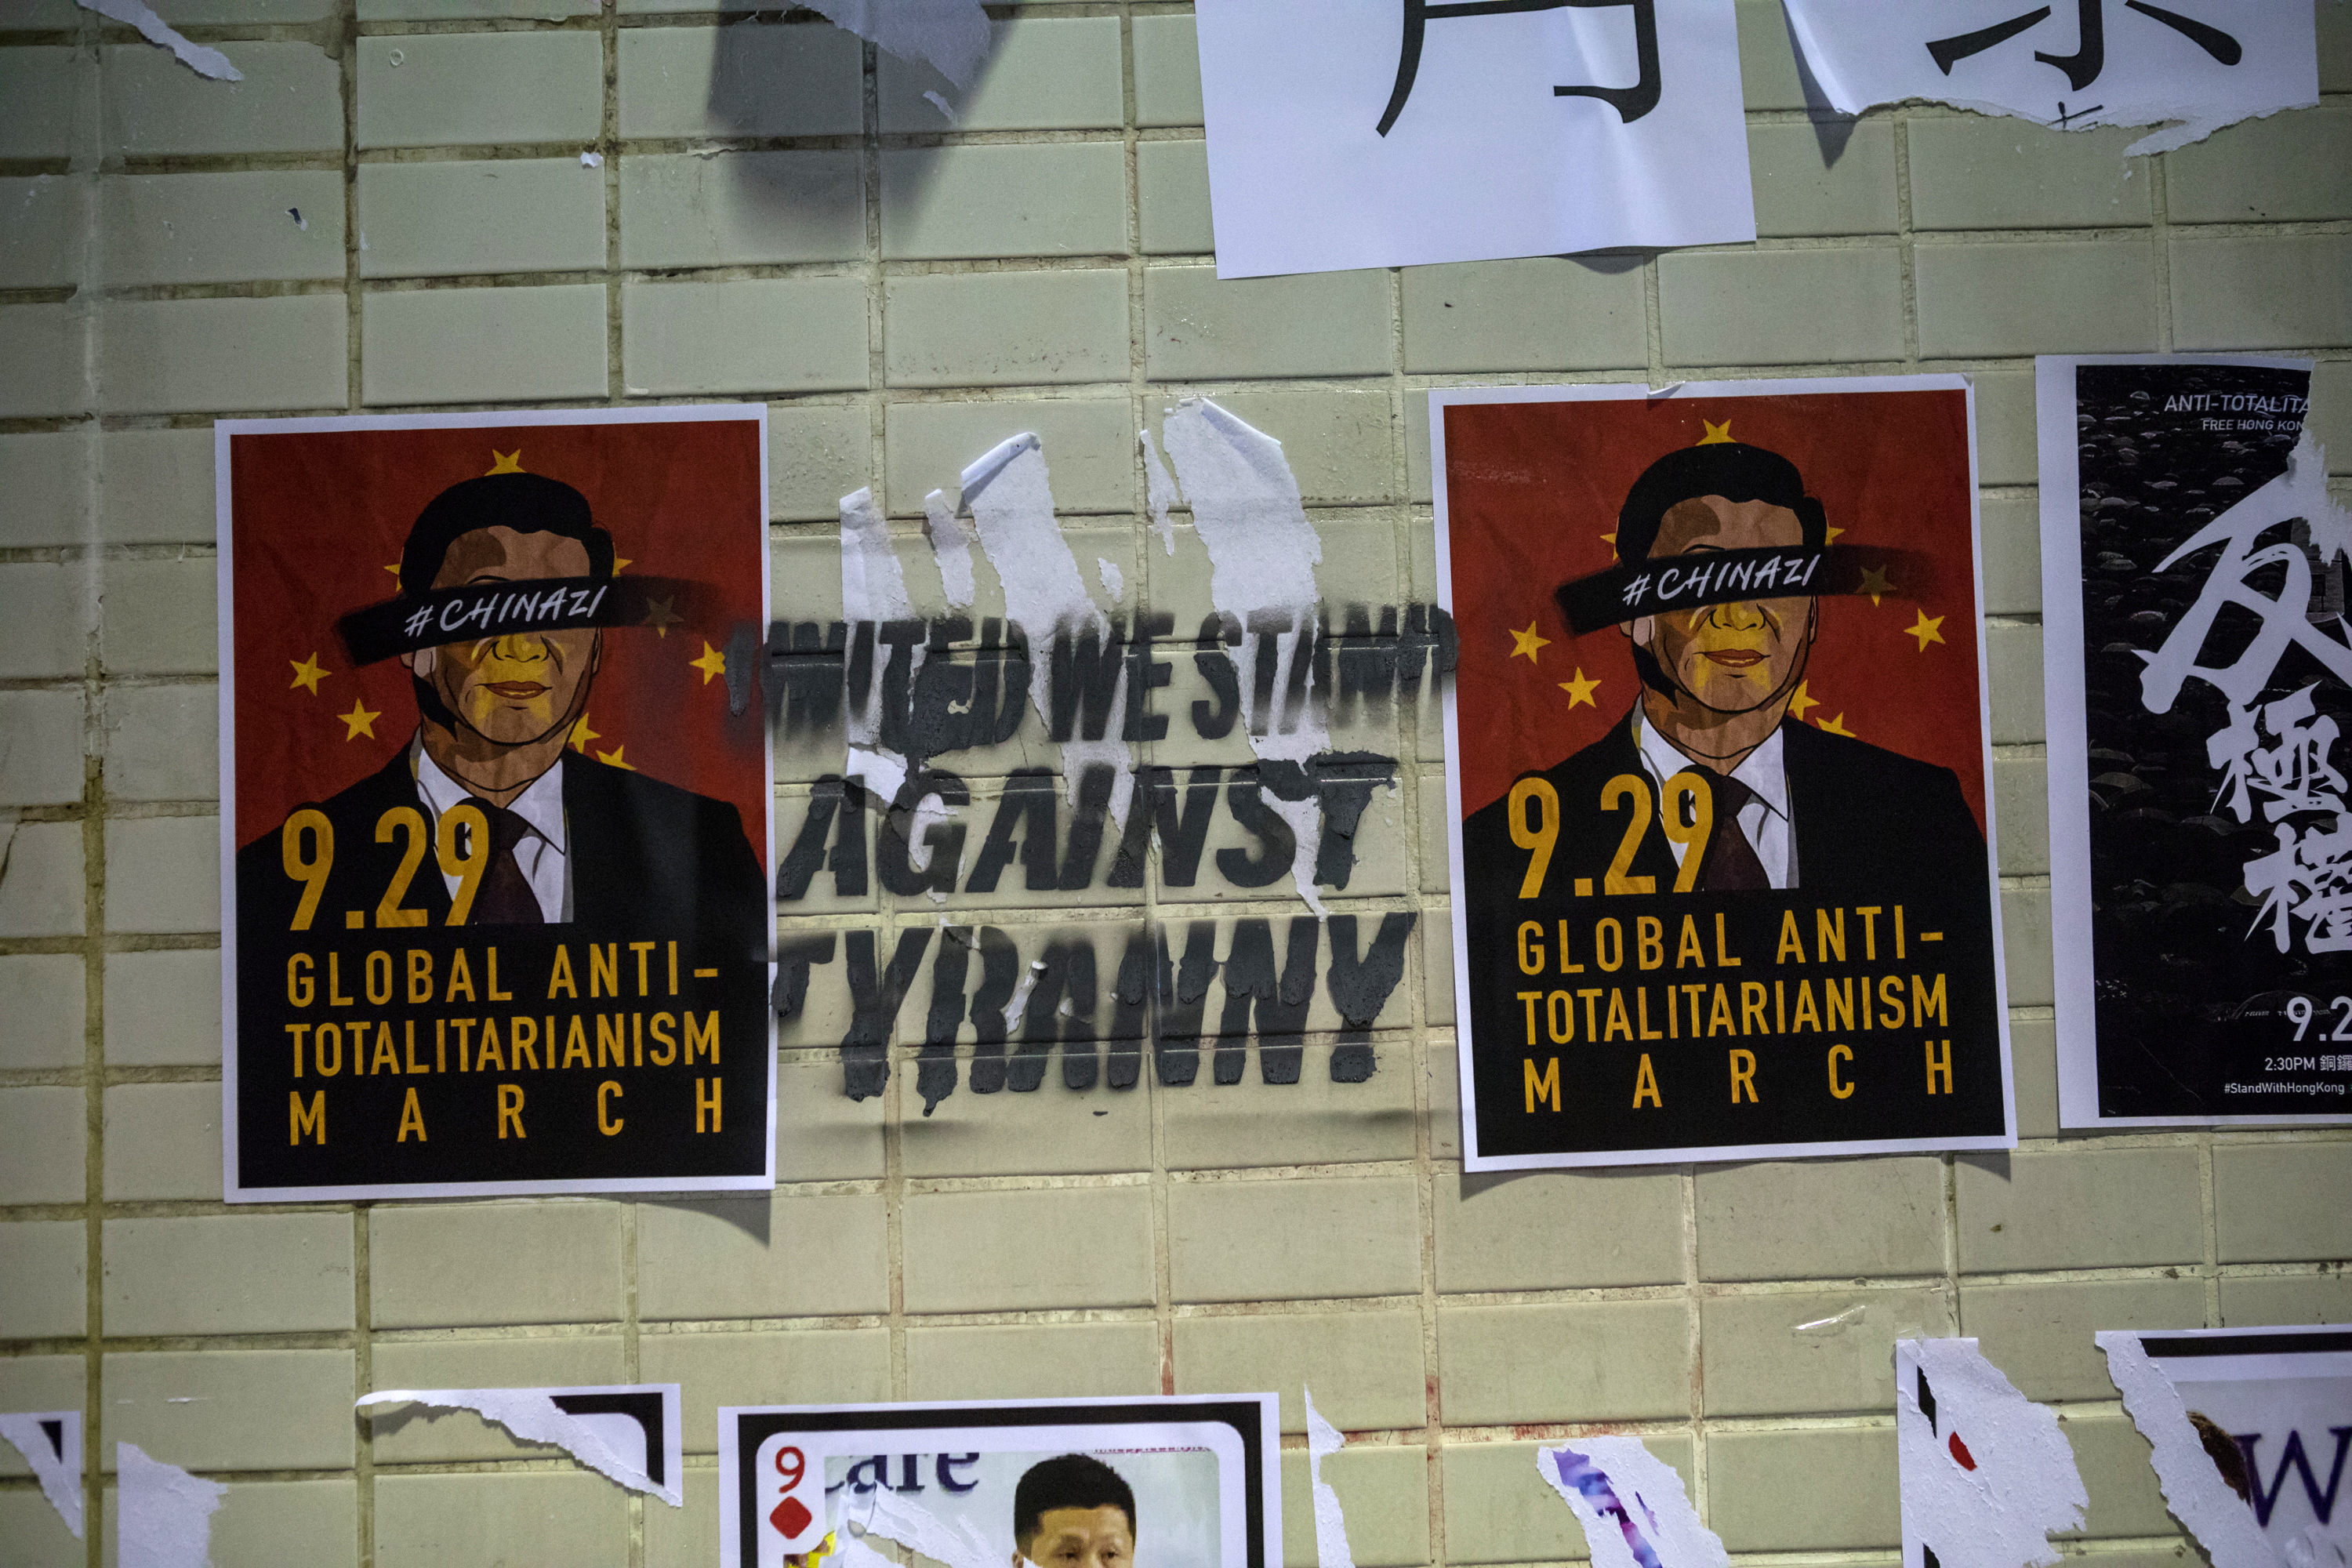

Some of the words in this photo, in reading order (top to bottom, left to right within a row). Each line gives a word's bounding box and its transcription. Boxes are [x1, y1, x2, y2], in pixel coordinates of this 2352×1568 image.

[2202, 419, 2234, 430] FREE
[2237, 419, 2274, 430] HONG
[404, 585, 608, 638] #CHINAZI
[1622, 554, 1821, 607] #CHINAZI
[775, 750, 1399, 900] AGAINST
[1508, 772, 1714, 899] 9.29
[282, 804, 489, 931] 9.29
[287, 946, 513, 1007] GLOBAL
[547, 940, 719, 1000] ANTI-
[1517, 913, 1741, 975] GLOBAL
[1776, 905, 1944, 964] ANTI-
[1516, 973, 1948, 1046] TOTALITARIANISM
[285, 1010, 720, 1078] TOTALITARIANISM
[1523, 1040, 1954, 1113] MARCH
[2264, 1056, 2316, 1072] 2:30PM
[289, 1077, 723, 1146] MARCH
[2224, 1082, 2345, 1095] #StandWithHongKong
[775, 1445, 805, 1494] 9
